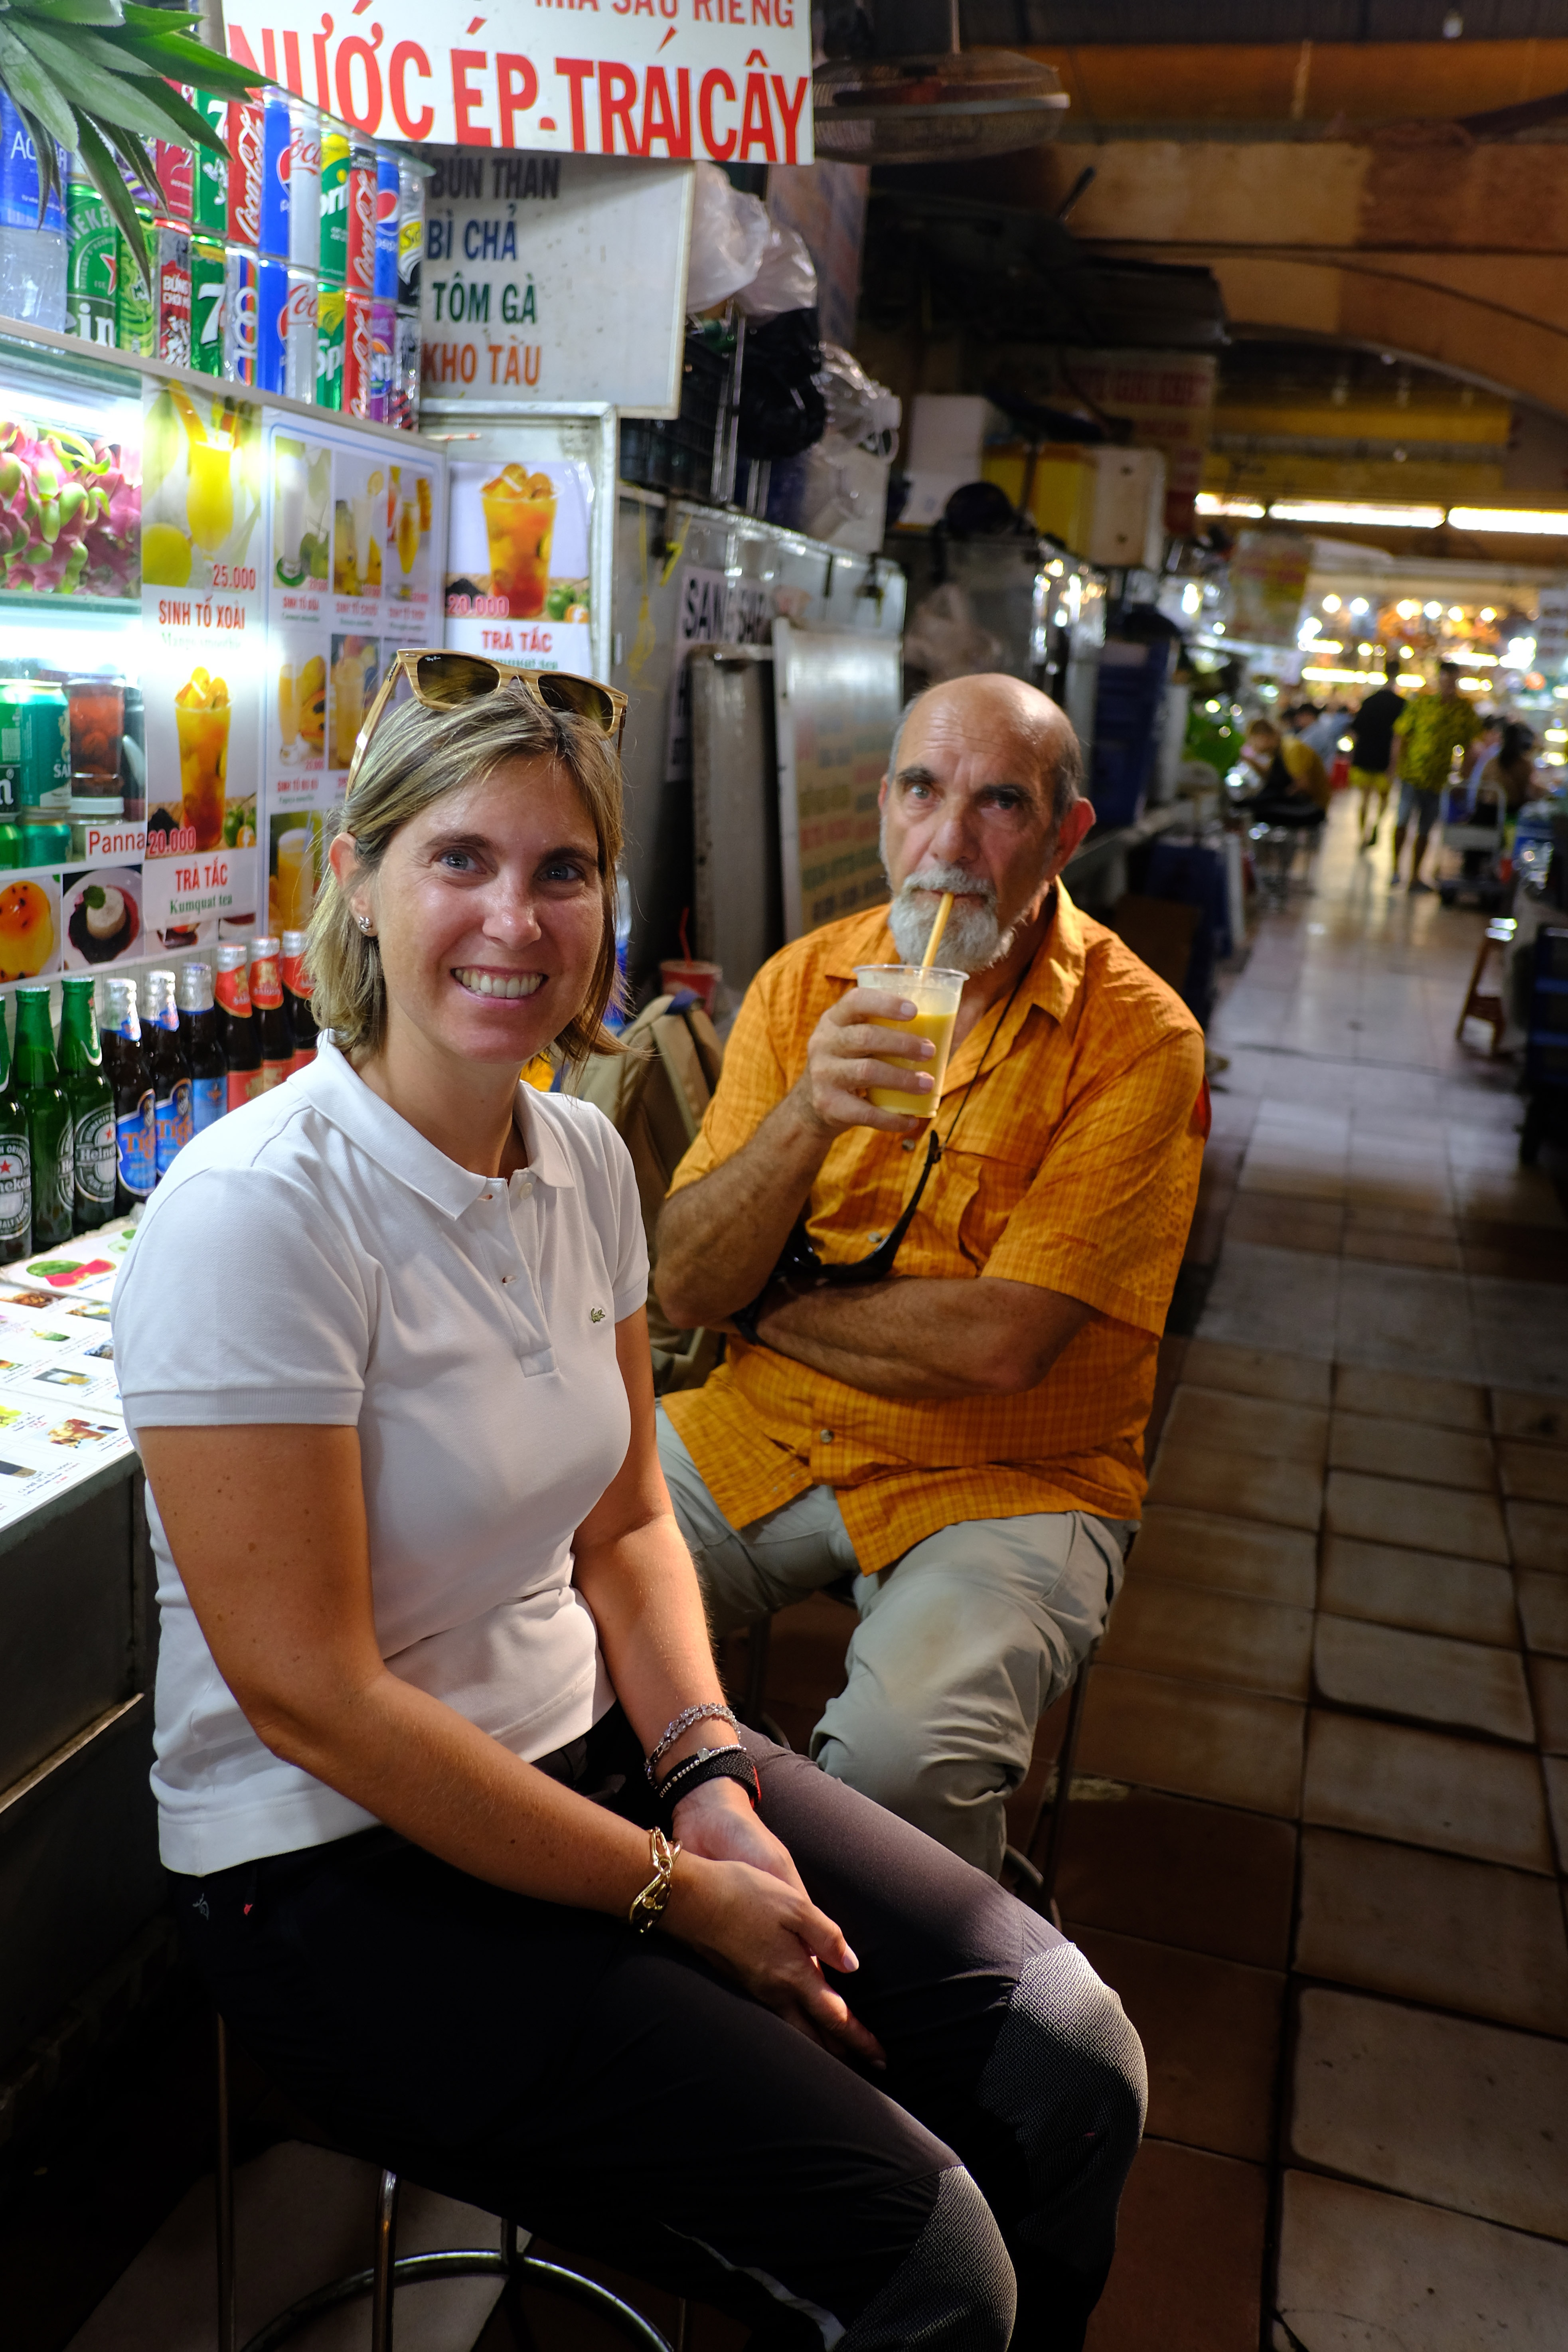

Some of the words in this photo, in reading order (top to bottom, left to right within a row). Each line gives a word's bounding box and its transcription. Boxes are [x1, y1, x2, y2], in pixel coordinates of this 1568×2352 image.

[427, 209, 452, 260] BÌ
[464, 203, 517, 260] CHẢ
[432, 271, 490, 322] TÔM
[502, 272, 537, 324] GÀ
[421, 342, 477, 384] KHO
[488, 334, 541, 386] TÀU
[212, 563, 256, 591] 25.000
[159, 598, 191, 626] SINH
[195, 594, 212, 628] TỐ
[216, 598, 246, 630] XOÀI
[482, 626, 514, 650] TRÀ
[89, 830, 146, 855] Panna
[148, 826, 196, 856] 20.000
[176, 861, 200, 893] TRÀ
[170, 895, 216, 915] Kumquat
[219, 894, 233, 906] tea
